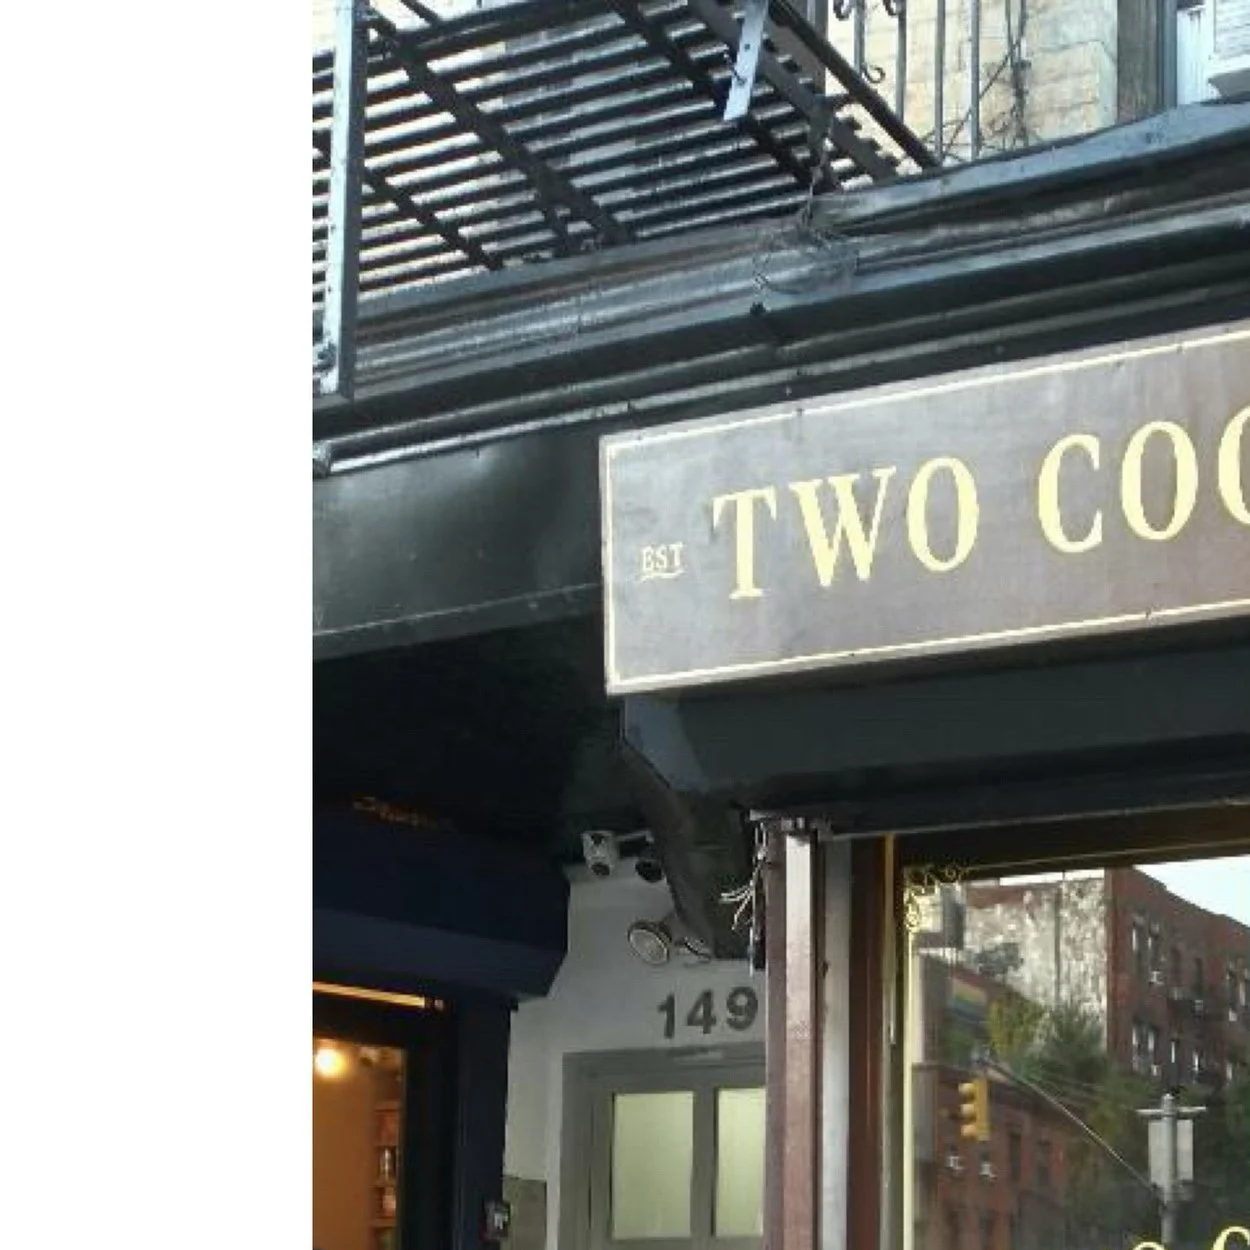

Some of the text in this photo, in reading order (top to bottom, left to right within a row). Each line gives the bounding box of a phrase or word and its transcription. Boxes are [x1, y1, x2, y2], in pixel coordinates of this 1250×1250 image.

[712, 456, 981, 600] TWO
[640, 541, 685, 574] EST
[656, 985, 759, 1039] 149
